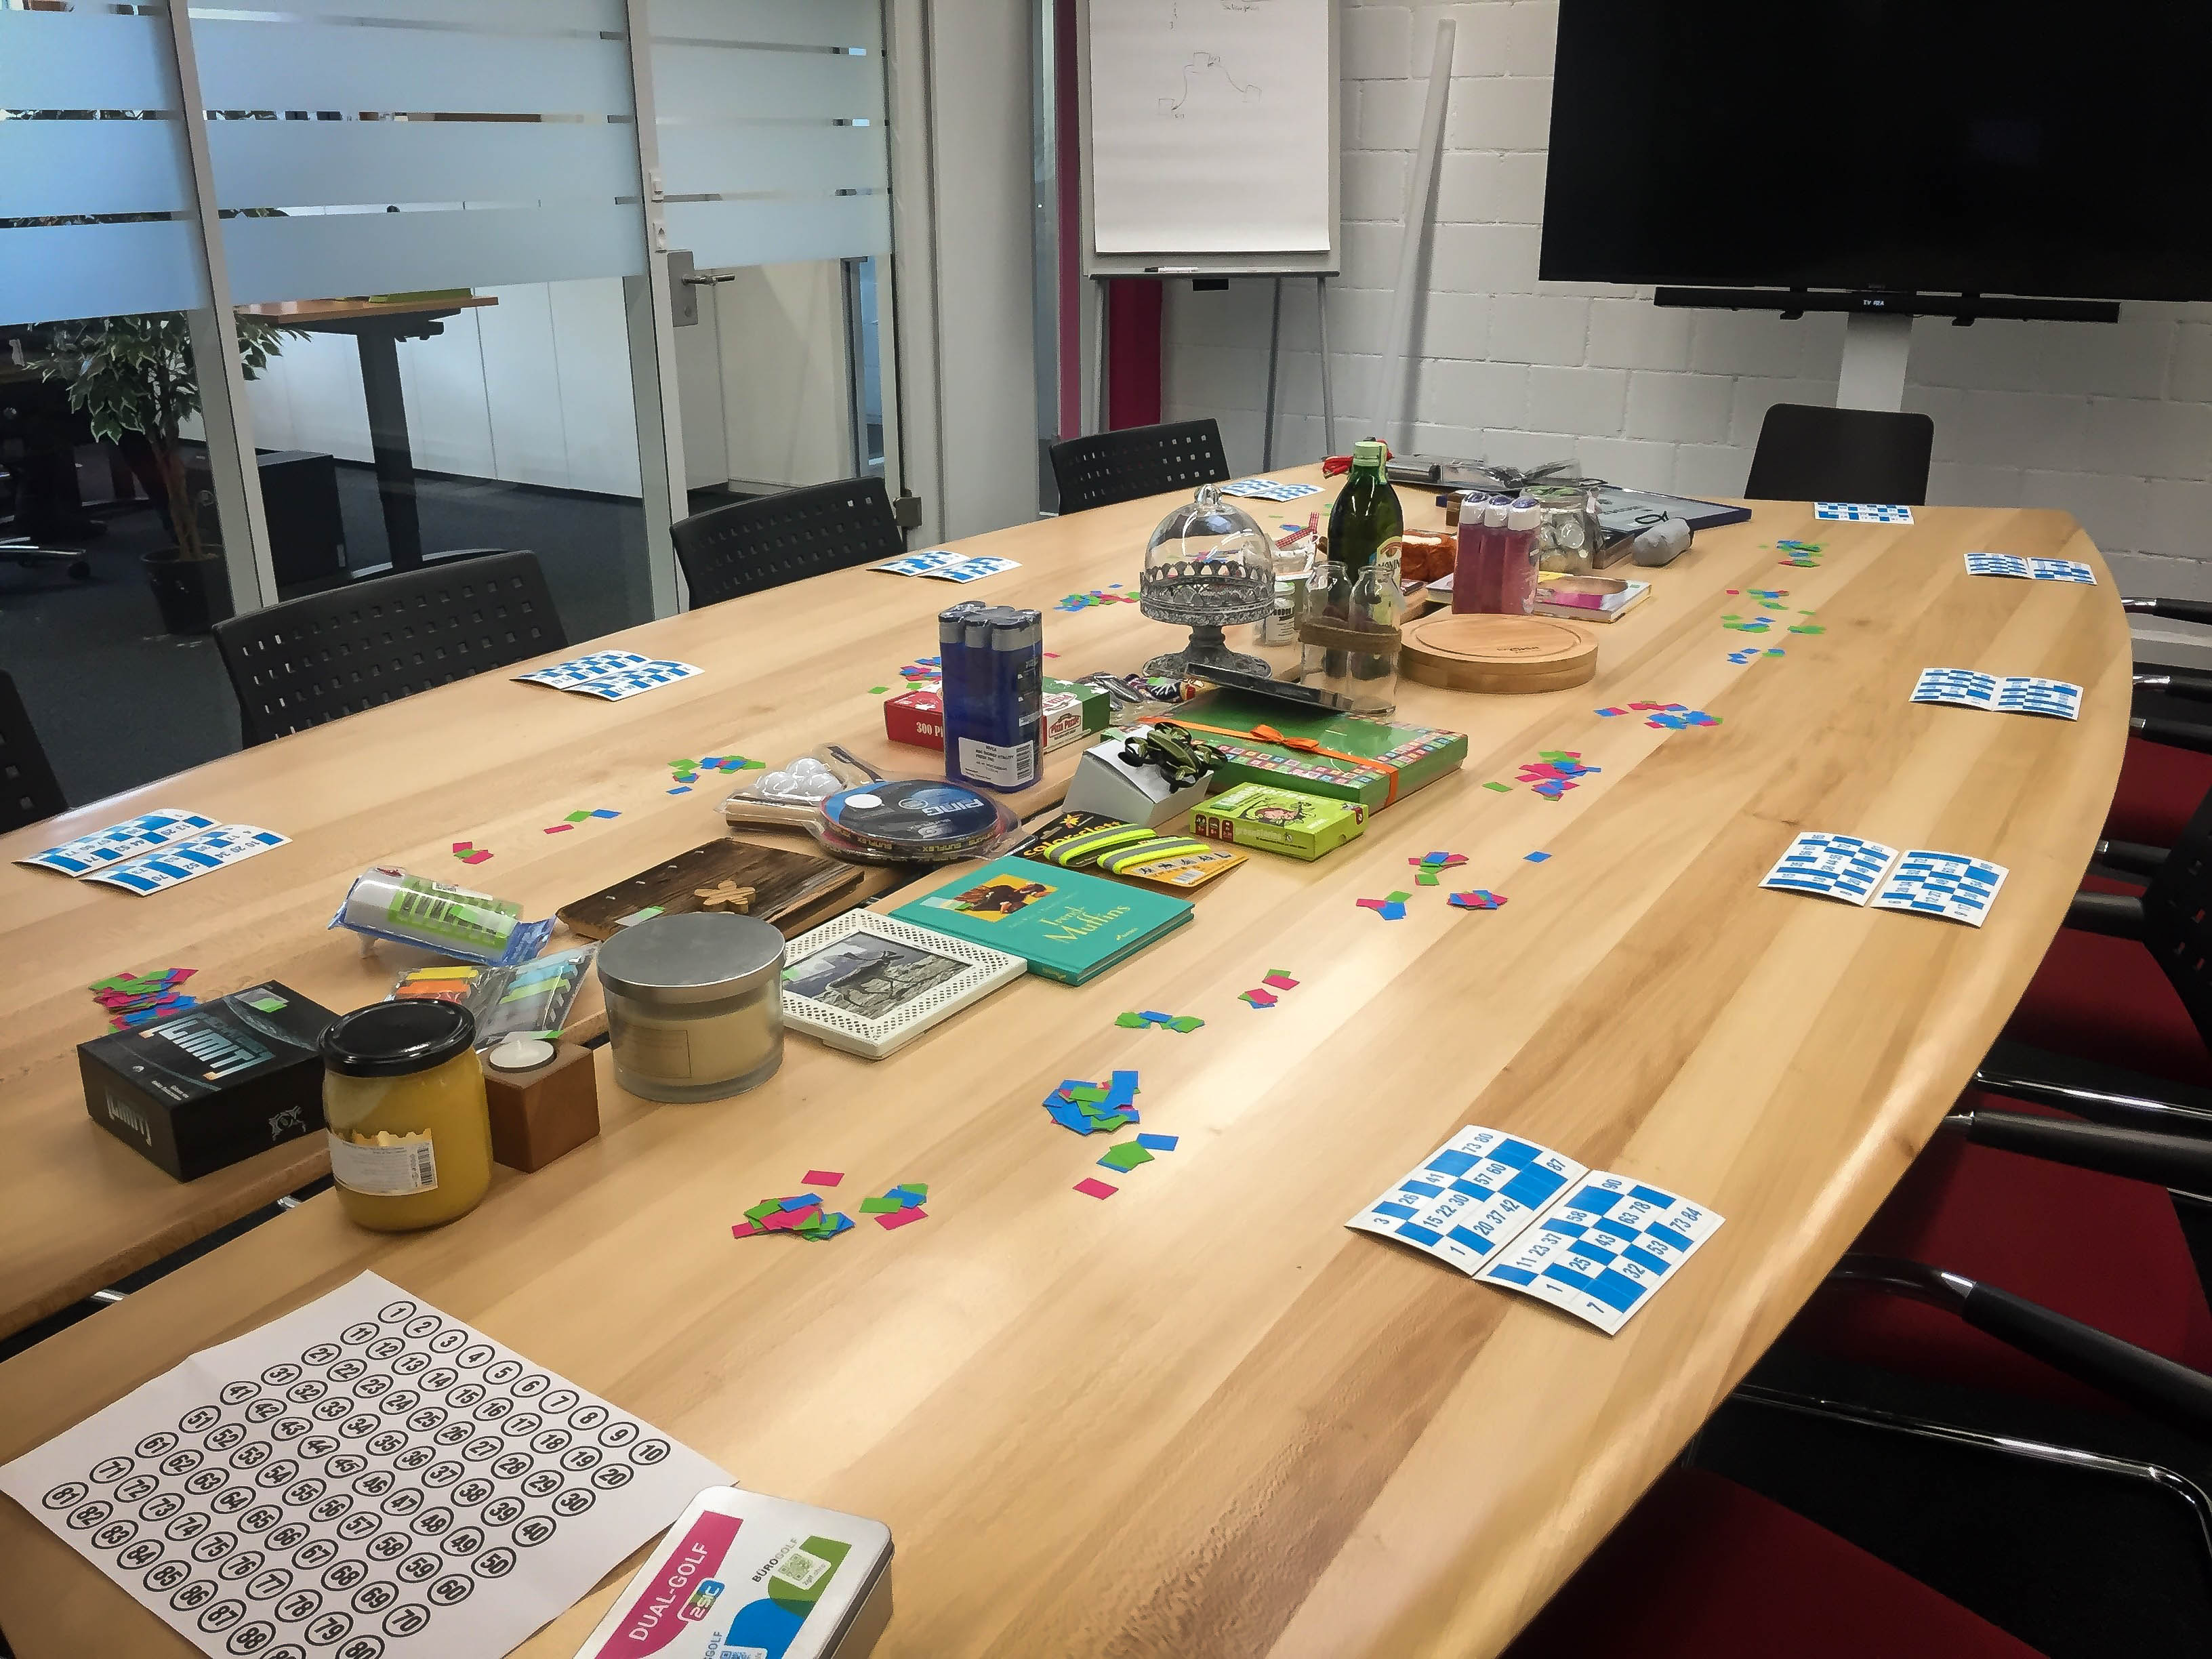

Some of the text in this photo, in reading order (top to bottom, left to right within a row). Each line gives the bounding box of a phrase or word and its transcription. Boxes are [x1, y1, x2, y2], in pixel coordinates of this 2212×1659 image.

[916, 722, 933, 735] 300
[1399, 1194, 1419, 1204] 26
[1425, 1173, 1444, 1183] 41
[1461, 1143, 1481, 1152] 73
[1474, 1133, 1493, 1143] 80
[1423, 1164, 1507, 1227] 15 22 30 57 60
[1450, 1158, 1565, 1255] 1 20 37 42 87
[1516, 1179, 1622, 1267] 11 23 37 58 90
[1546, 1202, 1651, 1292] 1 25 43 63 78
[1586, 1207, 1702, 1313] 7 32 53 73 84
[308, 1348, 588, 1511] 21 22 23 24 25 26 27 28 29 30
[350, 1328, 627, 1485] 11 12 13 14 15 16 17 18 19 20
[390, 1308, 663, 1461] 1 2 3 4 5 6 7 8 9 10
[188, 1411, 466, 1600] 51 52 53 54 55 56 57 58 59 60
[230, 1386, 509, 1574] 41 42 43 44 45 46 47 48 49 50
[270, 1368, 548, 1541] 31 32 33 34 35 36 37 38 39 40
[52, 1488, 267, 1650] 81 82 83 84 85 86 87 88
[99, 1461, 376, 1659] 71 72 73 74 75 76 77 78 79 80
[144, 1437, 422, 1632] 61 62 63 64 65 66 67 68 69 70
[628, 1542, 709, 1641] DUAL-GOLF
[751, 1538, 798, 1583] BÜROGOLF
